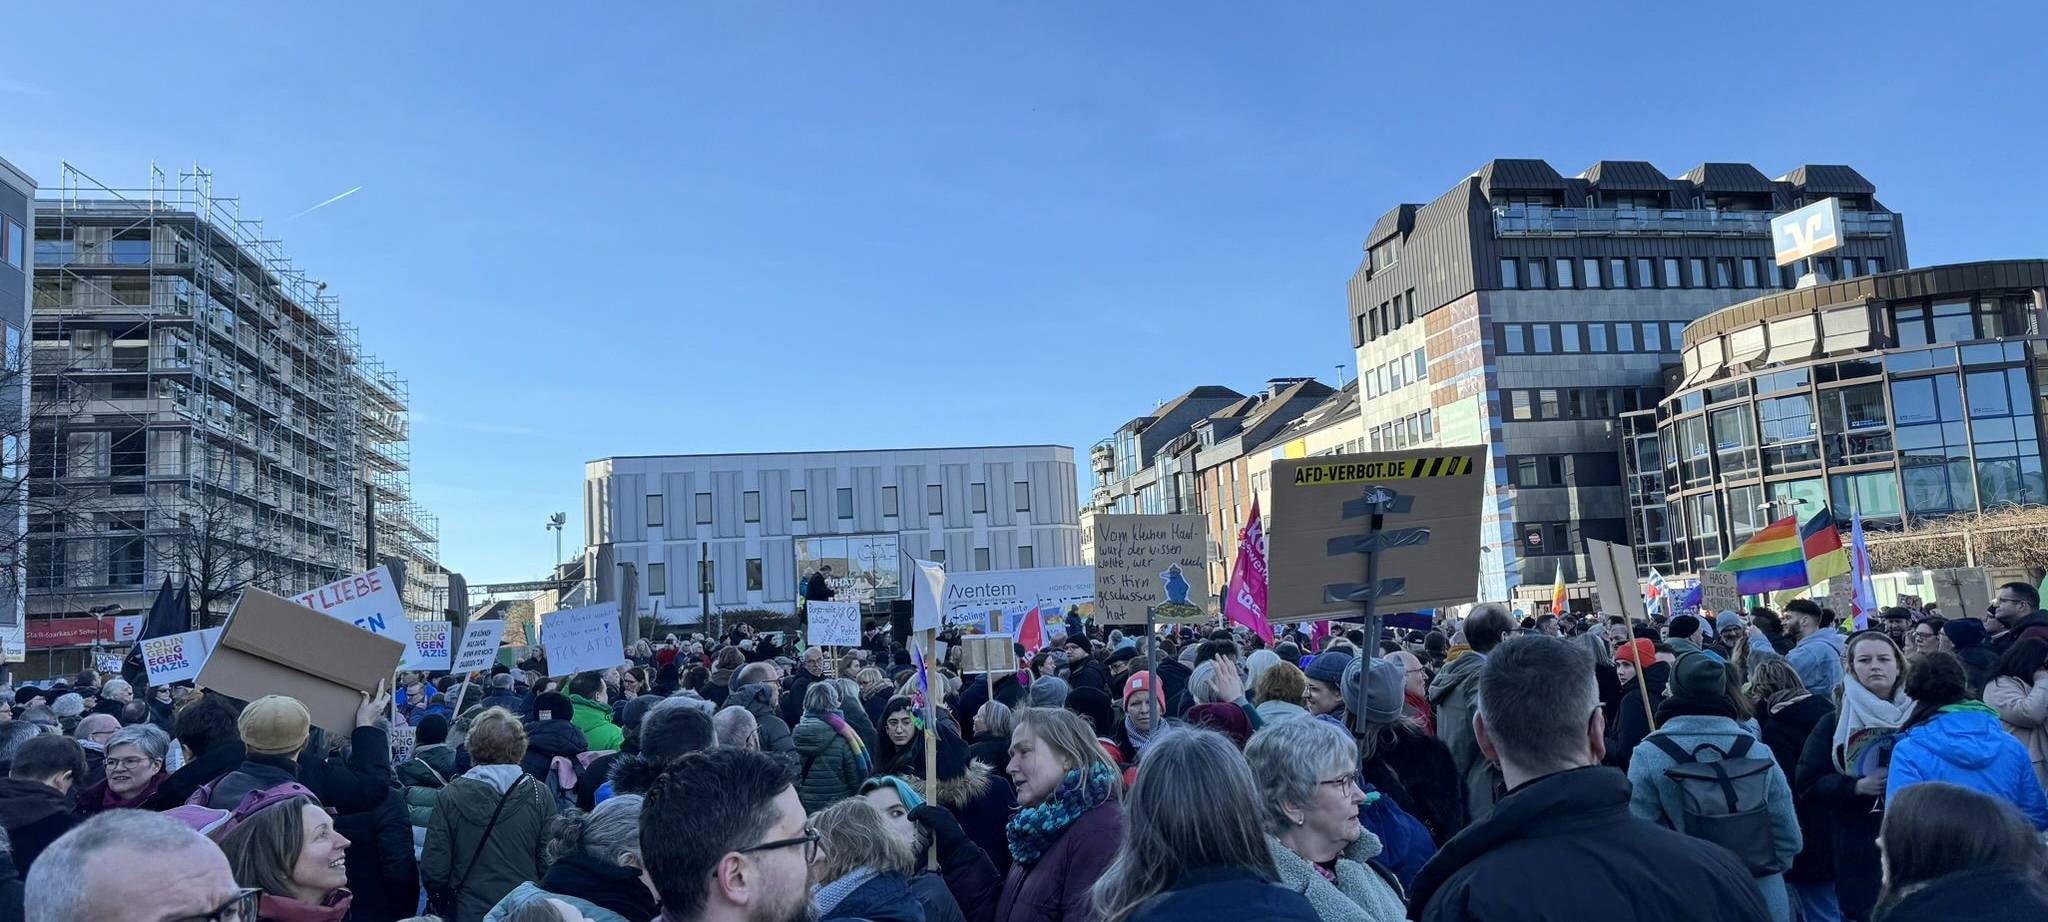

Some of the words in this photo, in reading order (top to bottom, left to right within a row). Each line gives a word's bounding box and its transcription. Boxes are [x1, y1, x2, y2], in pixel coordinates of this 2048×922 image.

[1295, 461, 1406, 483] AFD-VERBOT.DE
[1100, 523, 1128, 541] Vom
[1100, 543, 1123, 558] wurf
[1127, 542, 1146, 556] der
[1133, 559, 1153, 567] wer
[1100, 574, 1116, 584] ins
[1122, 575, 1149, 587] Hirn
[1709, 574, 1728, 584] HASS
[318, 571, 382, 609] LIEBE
[1099, 588, 1156, 608] geschissen
[1106, 606, 1126, 620] hat
[414, 624, 448, 632] SOLIN
[145, 636, 184, 650] SOLIN
[414, 633, 446, 641] GENG
[147, 646, 183, 658] GENG
[148, 653, 183, 667] EGEN
[150, 659, 190, 675] NAZIS
